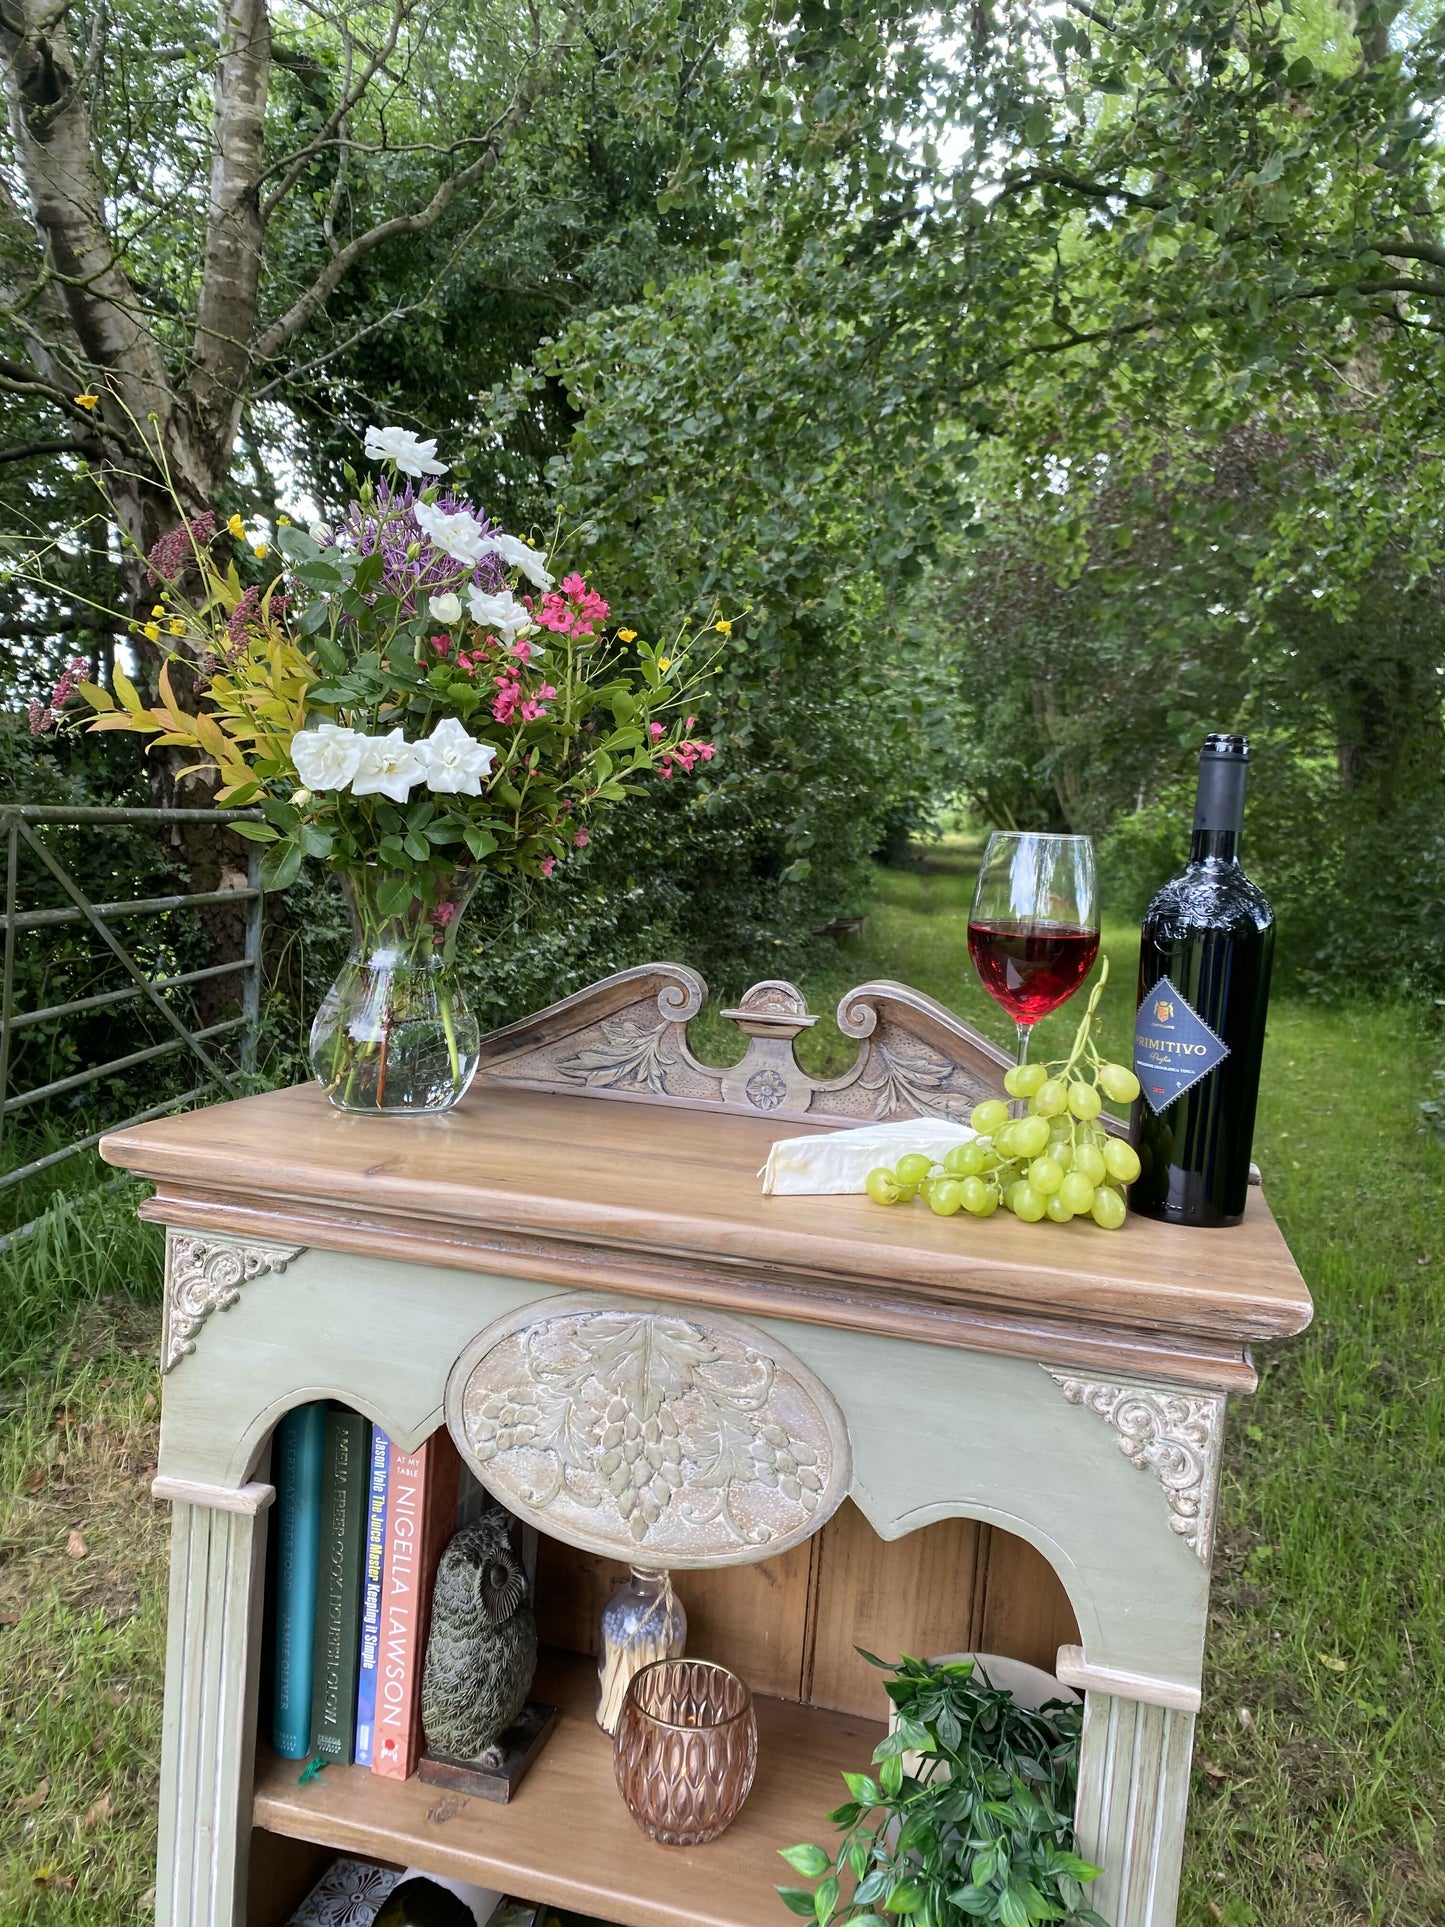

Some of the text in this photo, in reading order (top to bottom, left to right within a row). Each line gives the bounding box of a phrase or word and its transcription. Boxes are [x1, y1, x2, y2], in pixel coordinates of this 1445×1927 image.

[1136, 1036, 1207, 1056] PRIMITIVO
[334, 1425, 349, 1486] AMELIA
[396, 1456, 421, 1467] AT MY
[396, 1466, 419, 1478] TABLE
[279, 1429, 297, 1710] EVERYDAY SUPER FOOD JAMIE OLIVER
[362, 1437, 388, 1670] Jason Vale The Juice Master Keeping it Simple
[392, 1485, 416, 1594] NIGELLA
[382, 1606, 408, 1726] LAWSON
